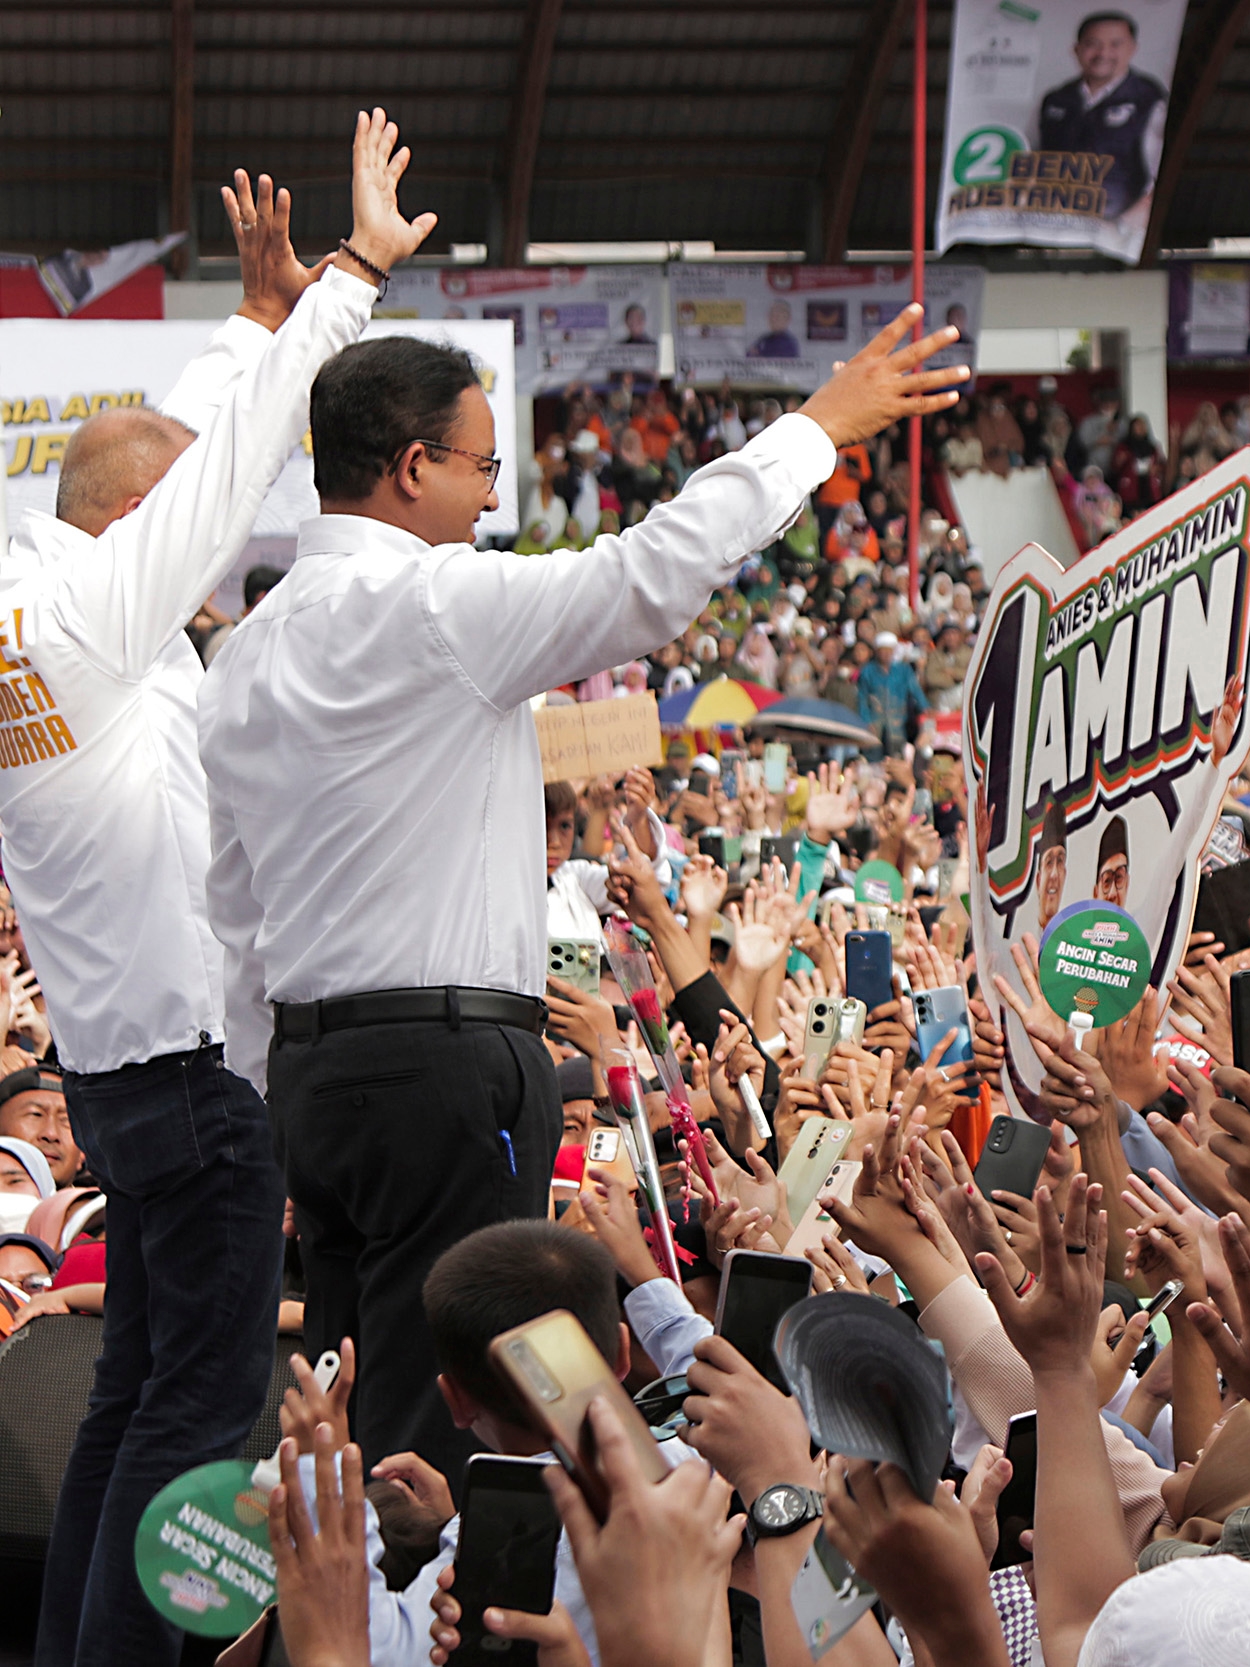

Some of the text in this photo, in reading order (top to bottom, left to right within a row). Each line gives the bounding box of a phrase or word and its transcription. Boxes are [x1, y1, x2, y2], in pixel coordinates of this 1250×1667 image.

[964, 134, 1006, 178] 2
[1012, 153, 1113, 184] BENY
[1046, 487, 1245, 652] ANIES & MUHAIMIN
[1027, 547, 1240, 810] AMIN
[1055, 958, 1131, 989] PERUBAHAN
[1056, 940, 1138, 974] ANGIN SEGAR
[159, 1519, 218, 1571] SEGAR
[214, 1555, 274, 1605] ANGIN
